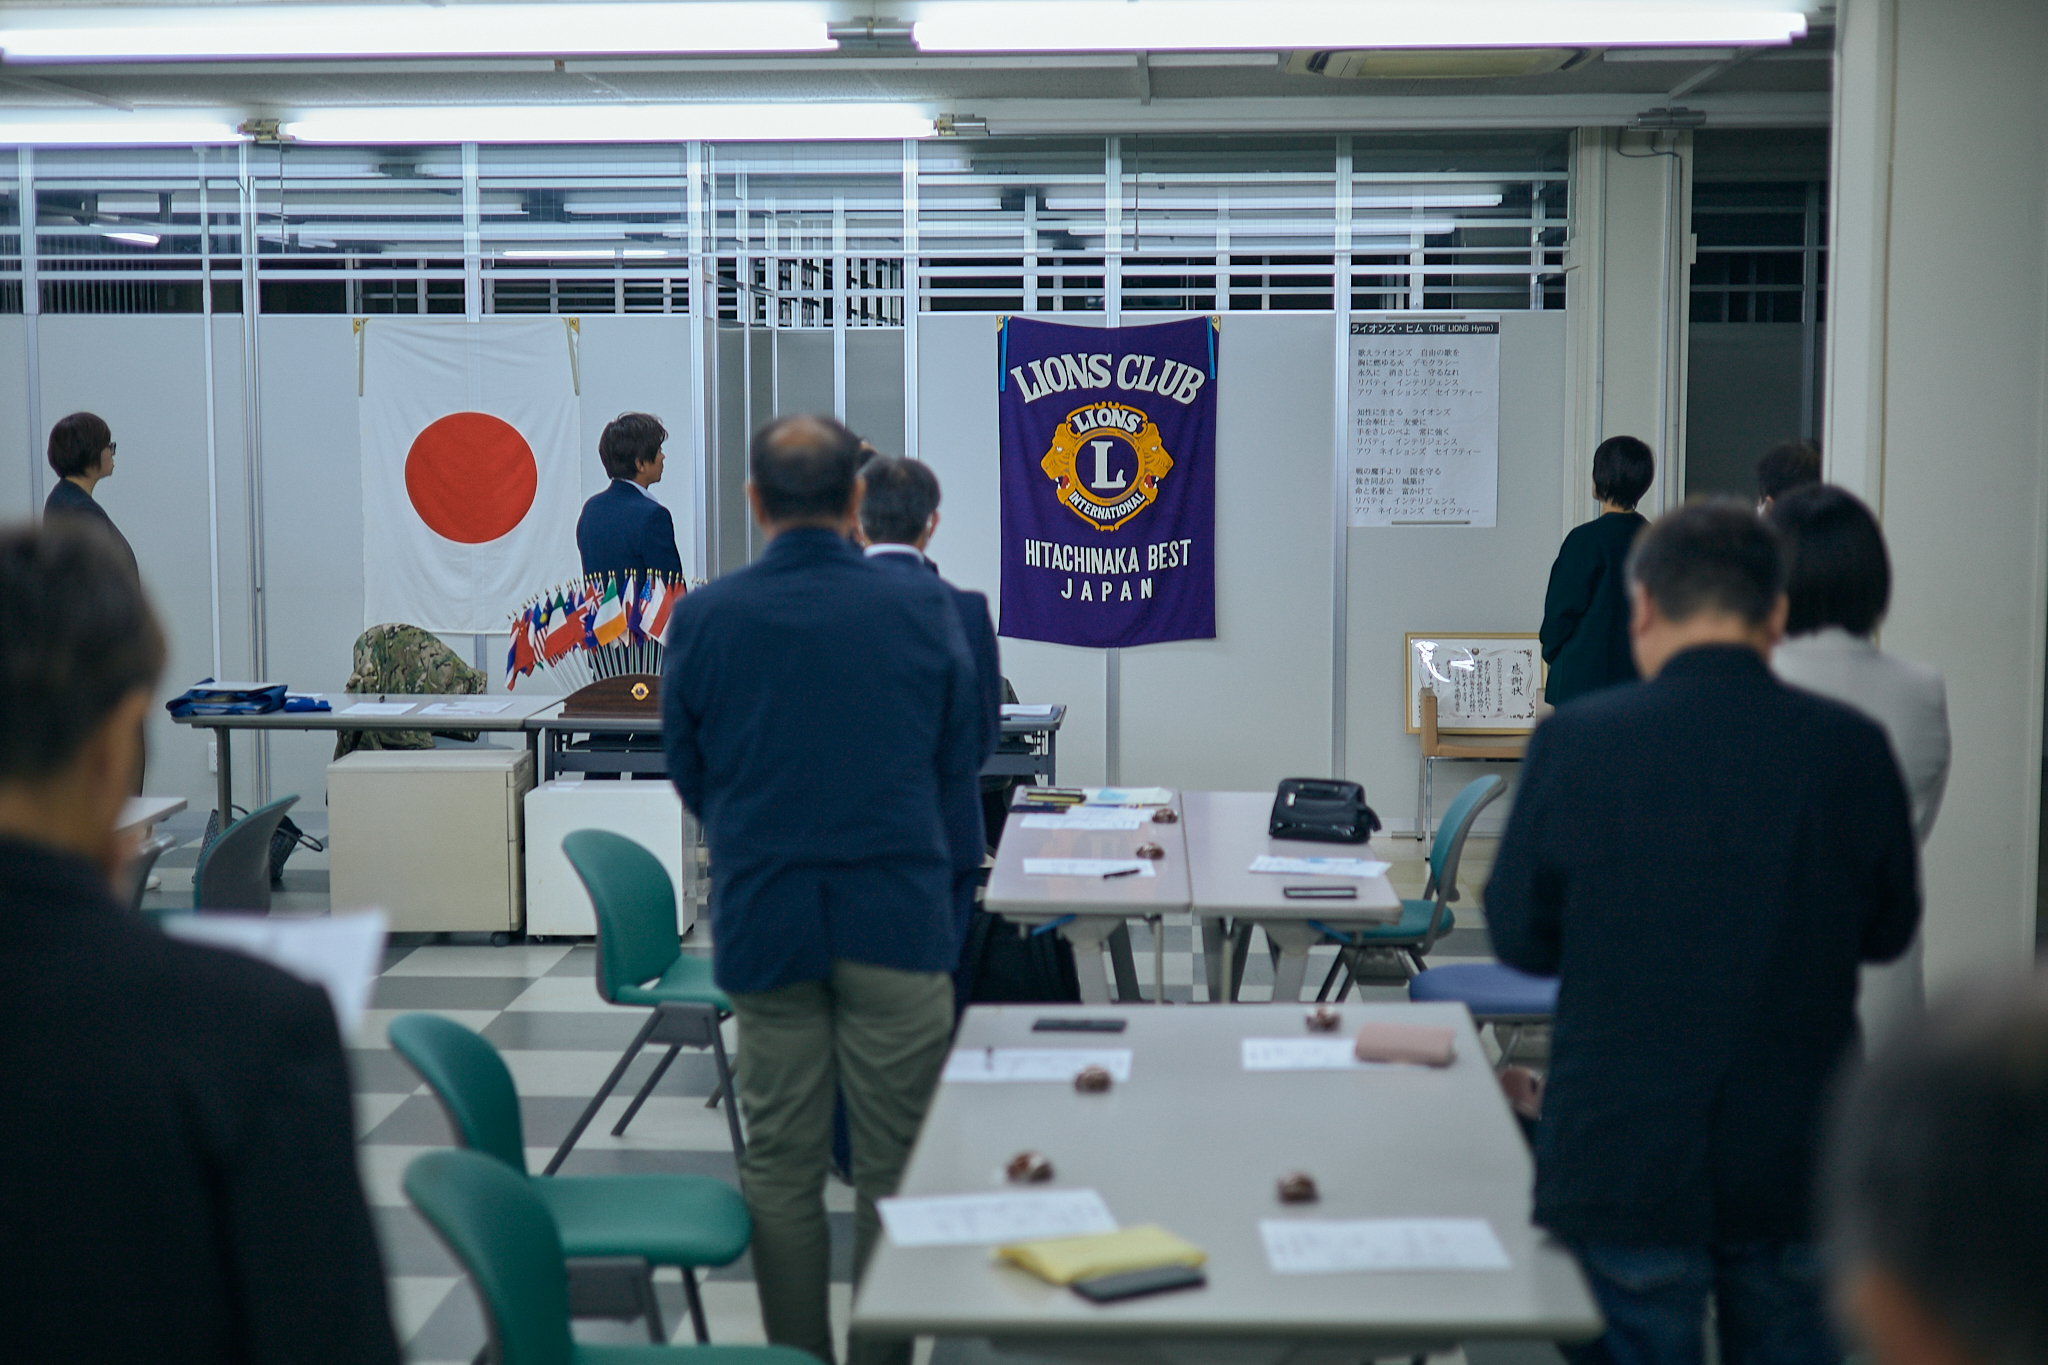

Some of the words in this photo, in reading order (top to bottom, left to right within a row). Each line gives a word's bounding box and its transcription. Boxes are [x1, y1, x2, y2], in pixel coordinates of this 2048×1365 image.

[1351, 324, 1424, 333] ライオンズ・ヒム
[1448, 324, 1470, 333] LIONS
[1357, 348, 1413, 357] 歌えライオンズ
[1412, 359, 1460, 367] デモクラシー
[1010, 353, 1112, 404] LIONS
[1116, 354, 1206, 405] CLUB
[1396, 379, 1460, 387] インテリジェンス
[1357, 388, 1373, 396] アワ
[1380, 388, 1429, 397] ネイションズ
[1357, 408, 1404, 416] 知性に生きる
[1411, 408, 1452, 416] ライオンズ
[1072, 408, 1141, 434] LIONS
[1357, 418, 1396, 427] 社会奉仕と
[1403, 418, 1427, 427] 友愛に
[1395, 438, 1459, 446] インテリジェンス
[1356, 447, 1372, 456] アワ
[1379, 447, 1427, 456] ネイションズ
[1090, 440, 1126, 489] L
[1068, 491, 1146, 520] INTERNATIONAL
[1394, 497, 1457, 505] インテリジェンス
[1354, 506, 1370, 515] アワ
[1378, 506, 1425, 515] ネイションズ
[1025, 539, 1140, 575] HITACHINAKA
[1147, 538, 1192, 571] BEST
[1511, 662, 1524, 697] 感謝状
